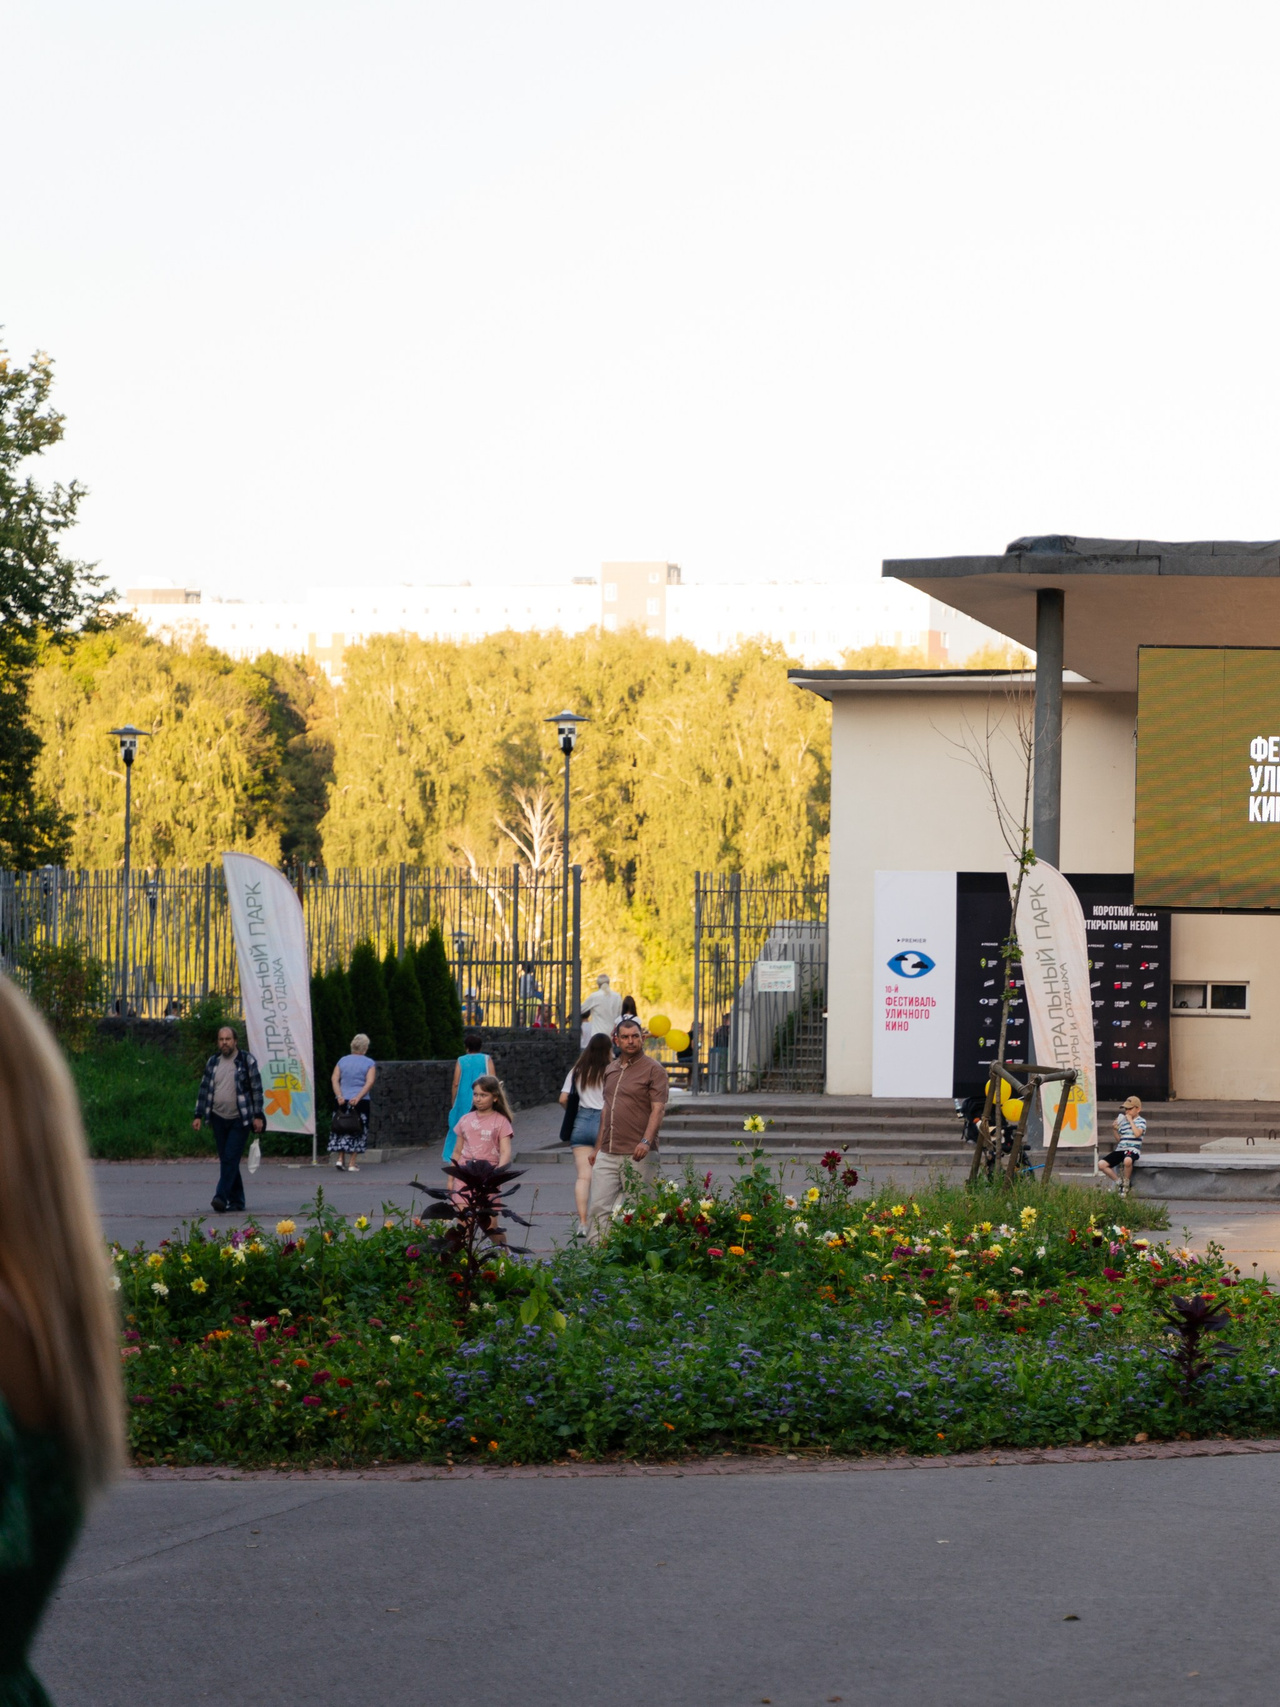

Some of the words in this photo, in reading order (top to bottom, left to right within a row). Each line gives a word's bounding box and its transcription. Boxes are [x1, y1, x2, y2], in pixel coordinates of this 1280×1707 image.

[245, 882, 265, 936] ПАРК
[1028, 883, 1052, 939] ПАРК
[1093, 904, 1135, 917] КОРОТКИЙ
[1129, 920, 1158, 931] НЕБОМ
[272, 957, 288, 1012] ОТДЫХА
[885, 984, 899, 994] 10-Й
[1060, 962, 1075, 1018] ОТДЫХА
[885, 996, 936, 1008] ФЕСТИВАЛЬ
[249, 944, 288, 1089] ЦЕНТРАЛЬНЫЙ
[885, 1008, 930, 1020] УЛИЧНОГО
[885, 1021, 909, 1032] КИНО
